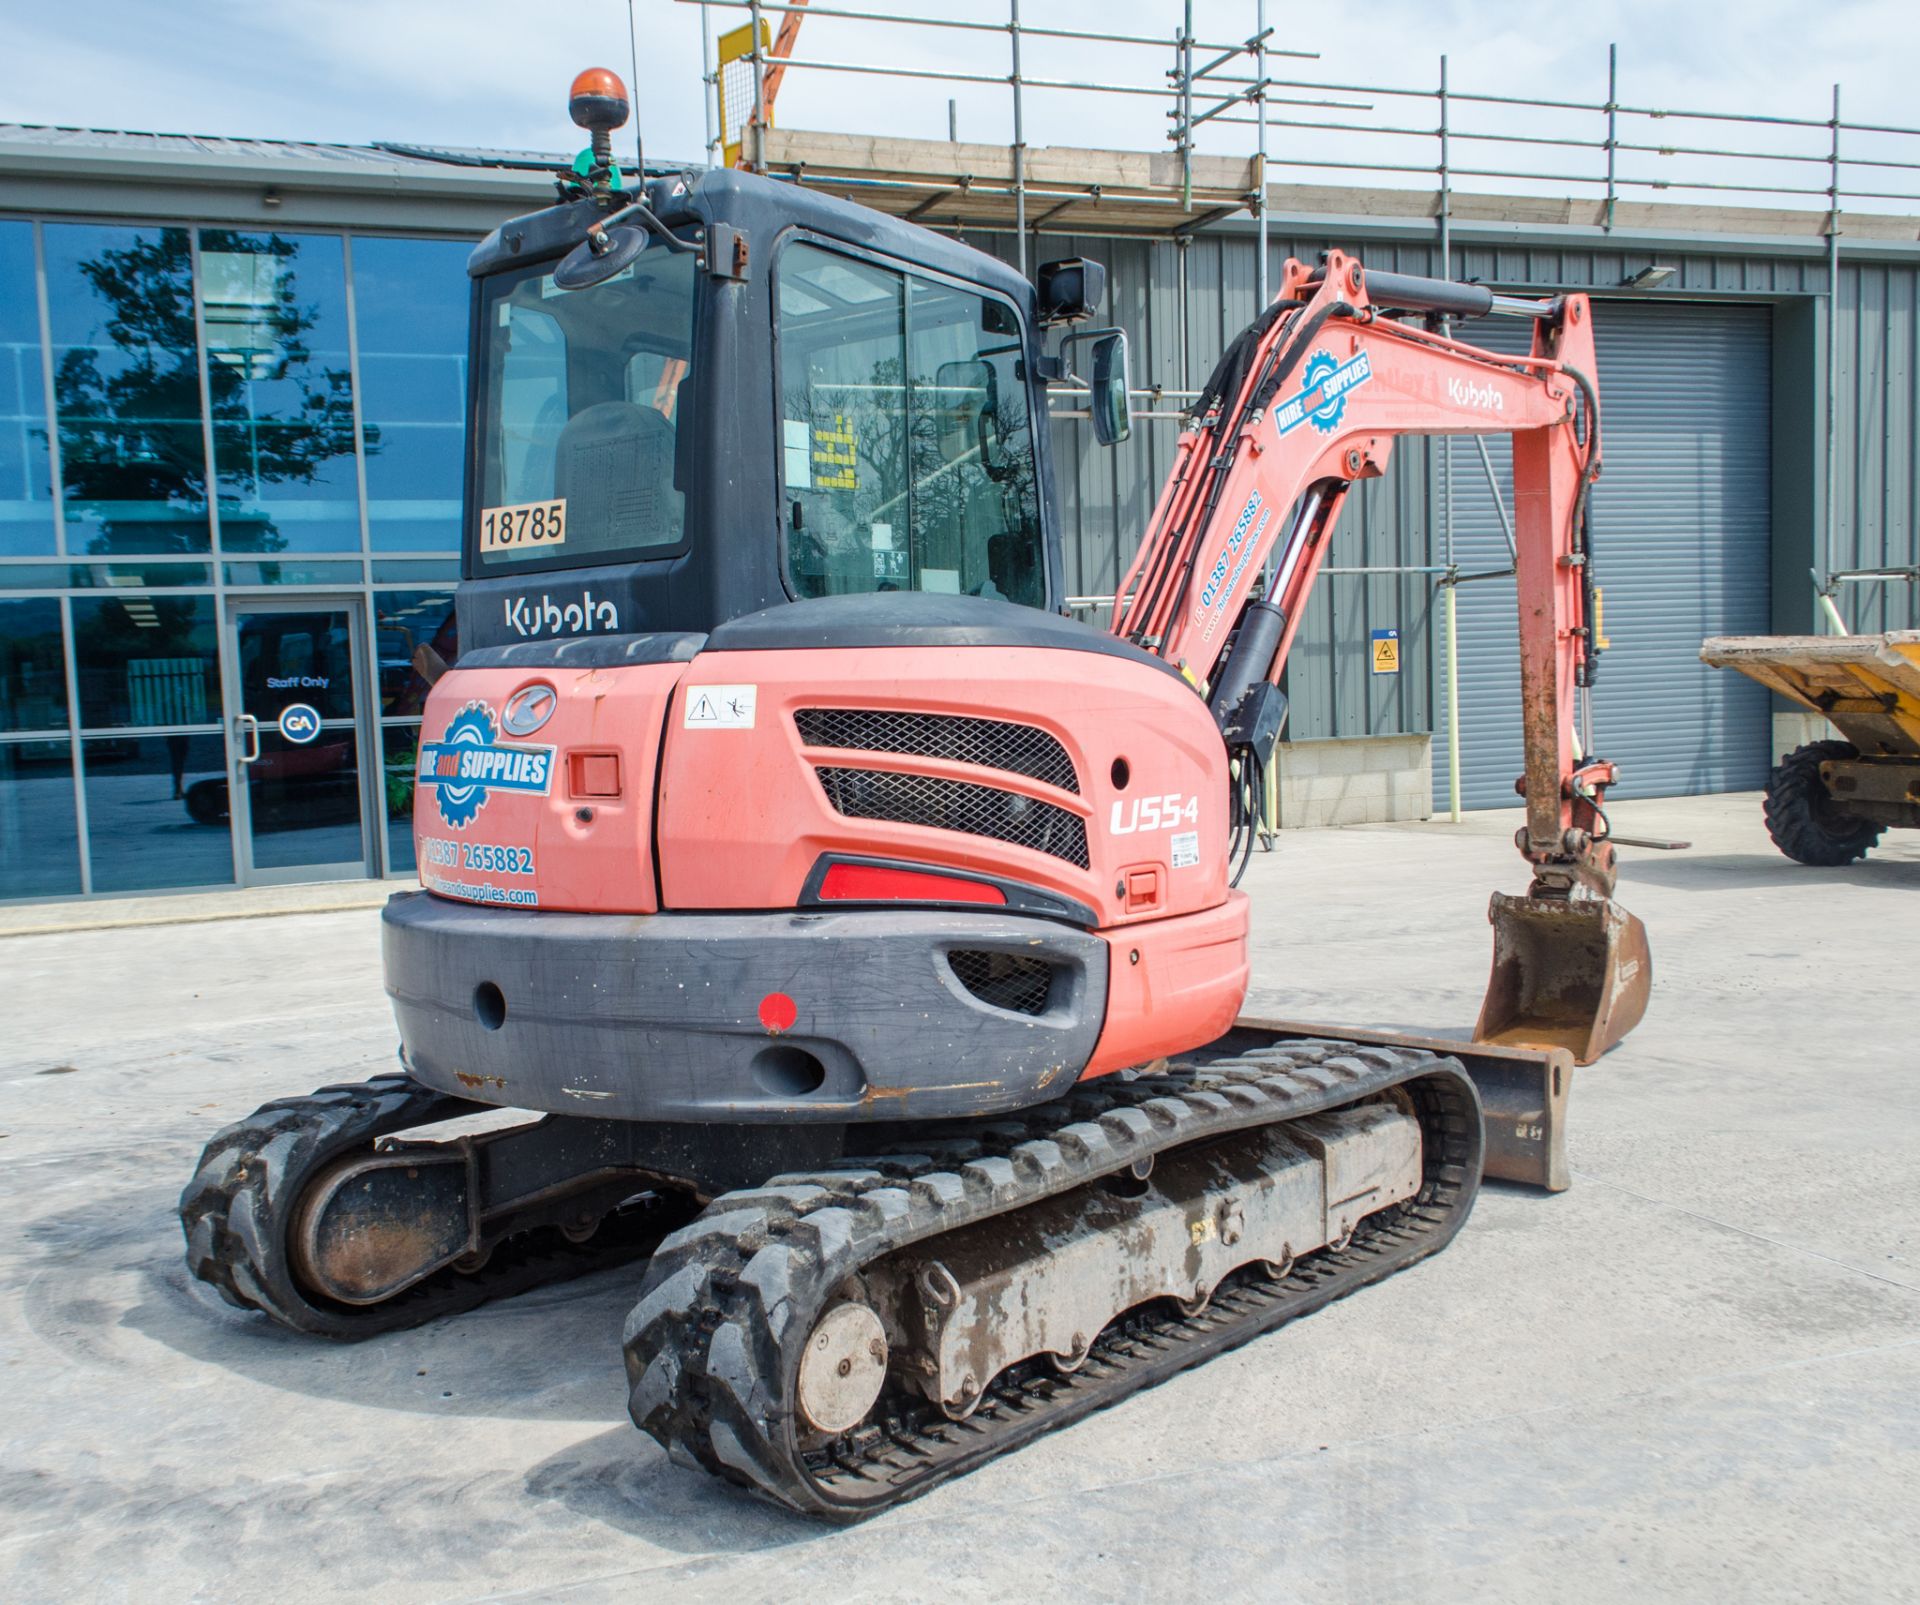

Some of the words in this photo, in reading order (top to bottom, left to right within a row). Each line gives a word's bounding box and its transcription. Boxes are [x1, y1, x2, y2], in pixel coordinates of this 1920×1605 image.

[1277, 399, 1304, 430] HIRE
[1323, 356, 1368, 400] SUPPLIES
[1449, 377, 1503, 409] Kubota
[485, 505, 562, 545] 18785
[1202, 550, 1231, 606] 01387
[1229, 490, 1262, 553] 265882
[504, 591, 618, 636] Kubota
[267, 677, 299, 688] Staff
[301, 676, 329, 688] Only
[286, 716, 313, 731] GA
[436, 751, 461, 777] and
[461, 751, 546, 784] SUPPLIES
[463, 844, 534, 874] 265882
